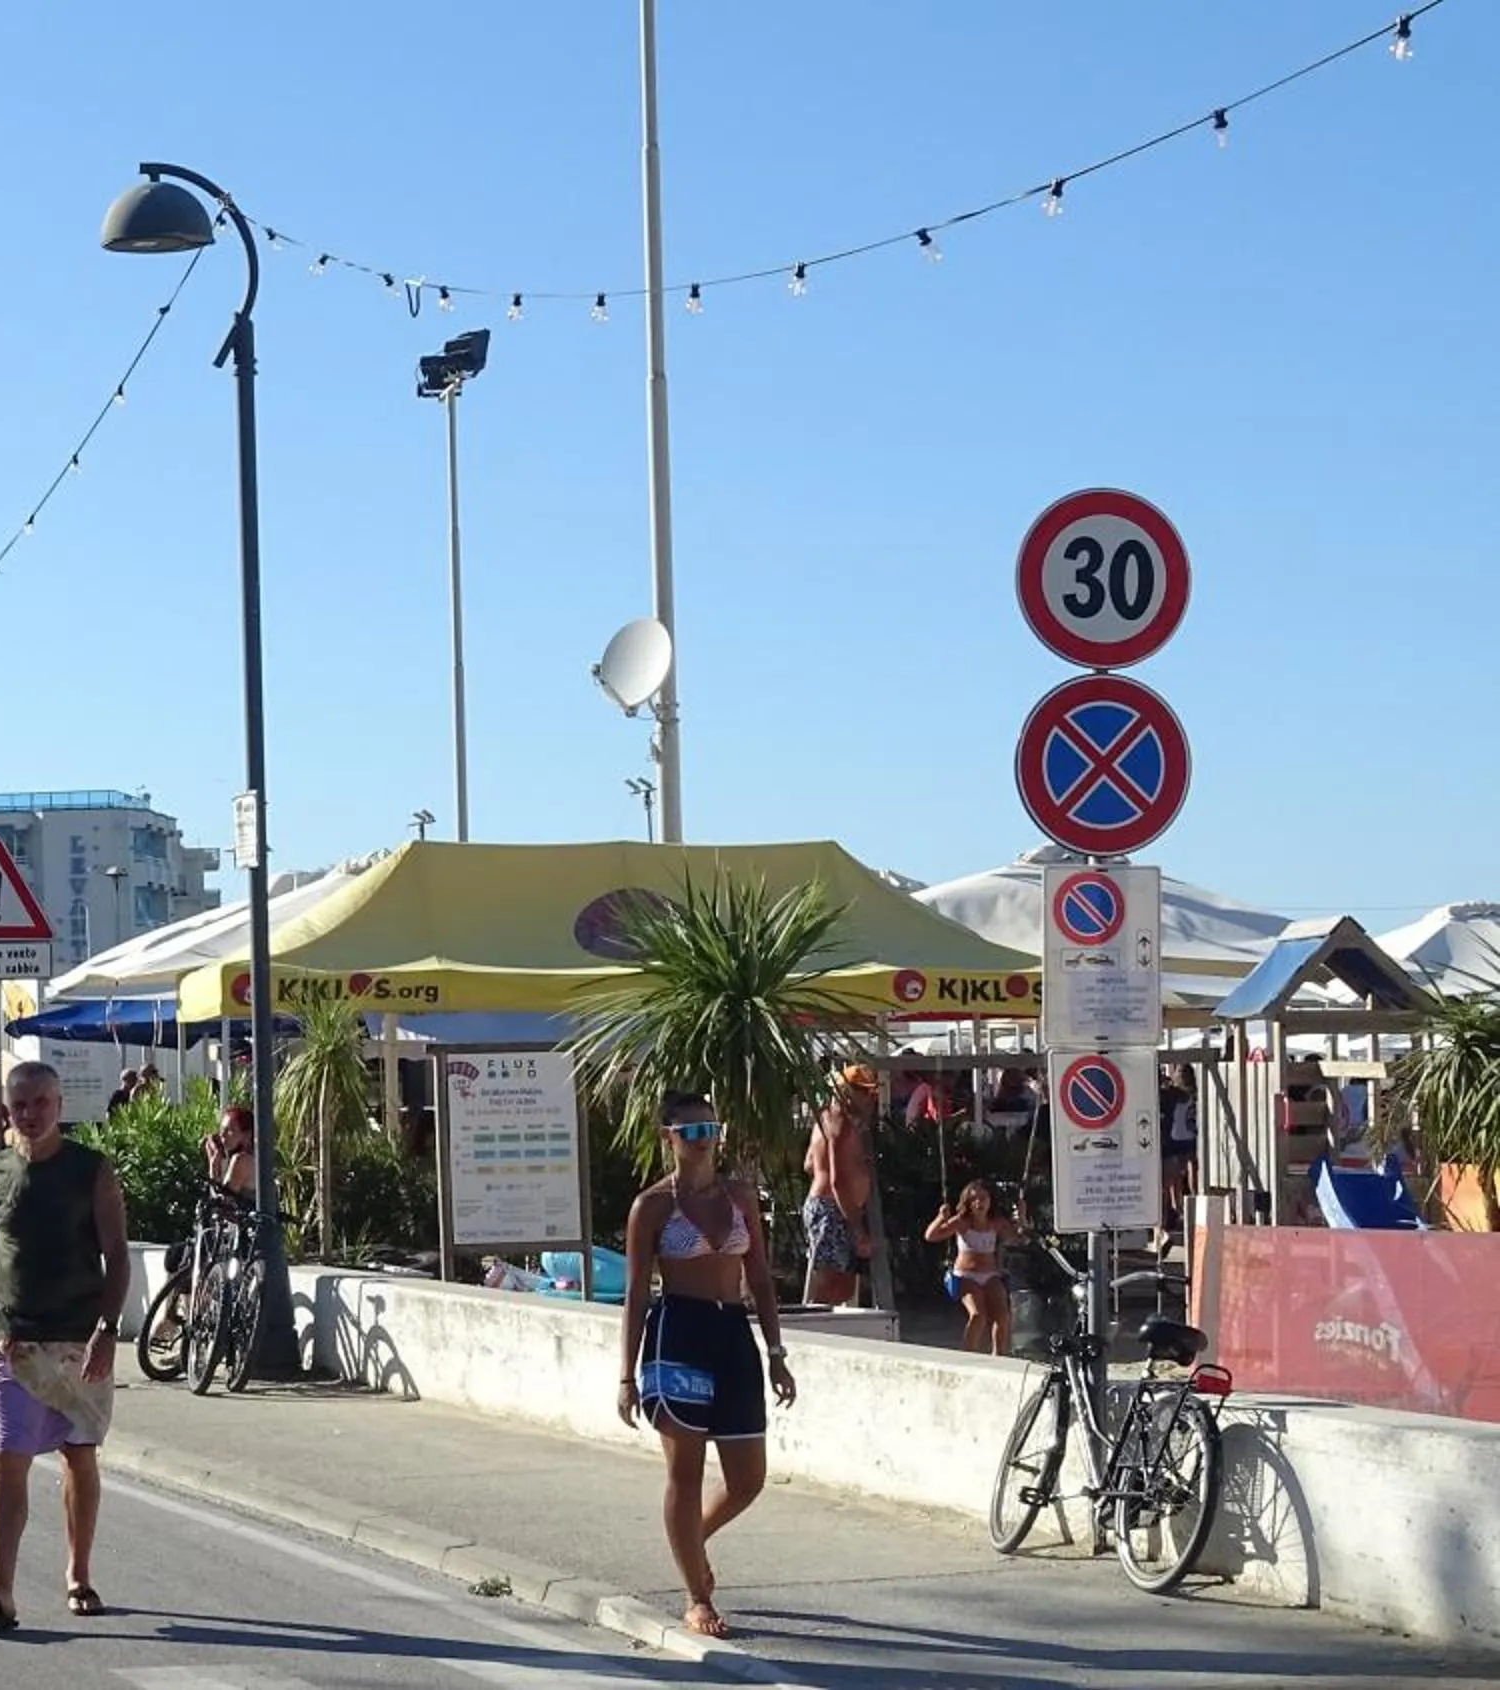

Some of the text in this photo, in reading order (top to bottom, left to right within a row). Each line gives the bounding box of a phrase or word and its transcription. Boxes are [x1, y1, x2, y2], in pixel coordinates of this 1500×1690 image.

[1062, 535, 1155, 621] 30
[68, 834, 87, 967] LEVANT
[5, 961, 41, 974] sabbia
[7, 947, 37, 960] vento
